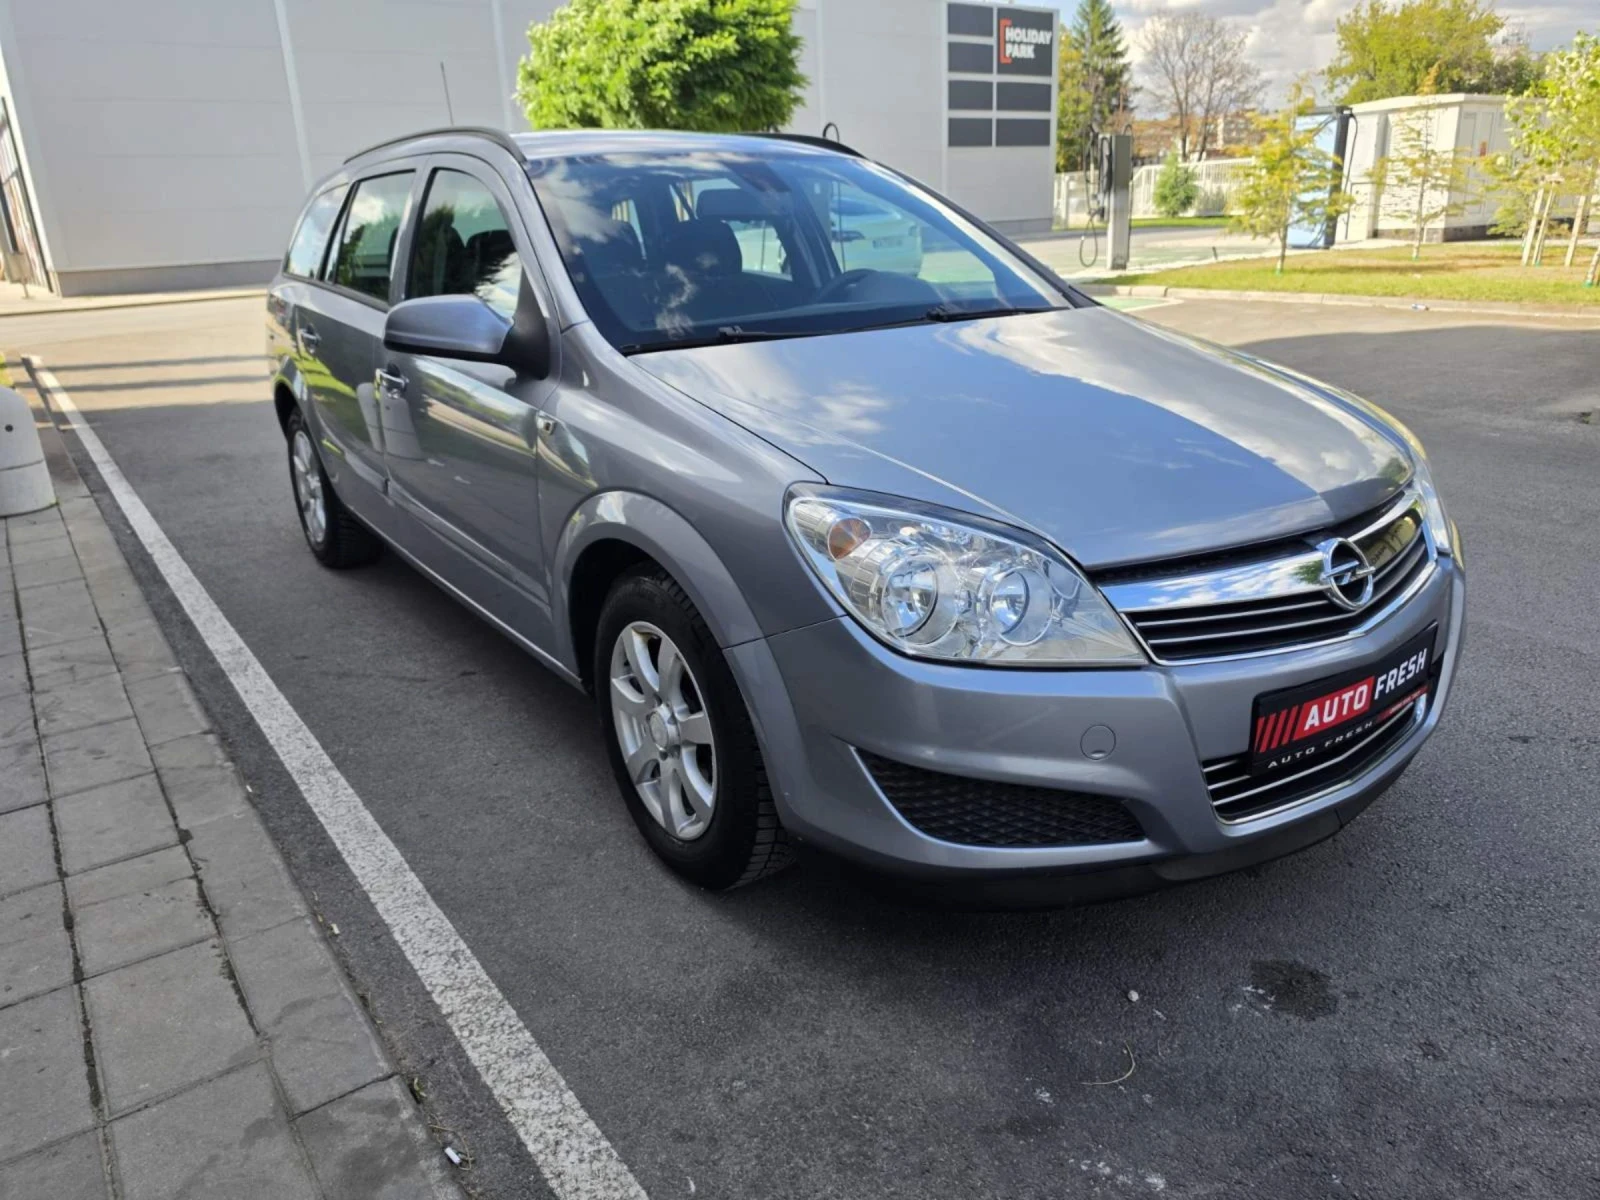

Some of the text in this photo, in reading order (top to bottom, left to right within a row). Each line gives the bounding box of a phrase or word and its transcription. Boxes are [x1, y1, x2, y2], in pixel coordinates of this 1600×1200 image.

[1005, 26, 1052, 44] HOLIDAY
[1005, 42, 1035, 58] PARK
[1304, 684, 1368, 731] AUTO
[1374, 648, 1427, 700] FRESH
[1267, 720, 1373, 769] AUTO FRESH
